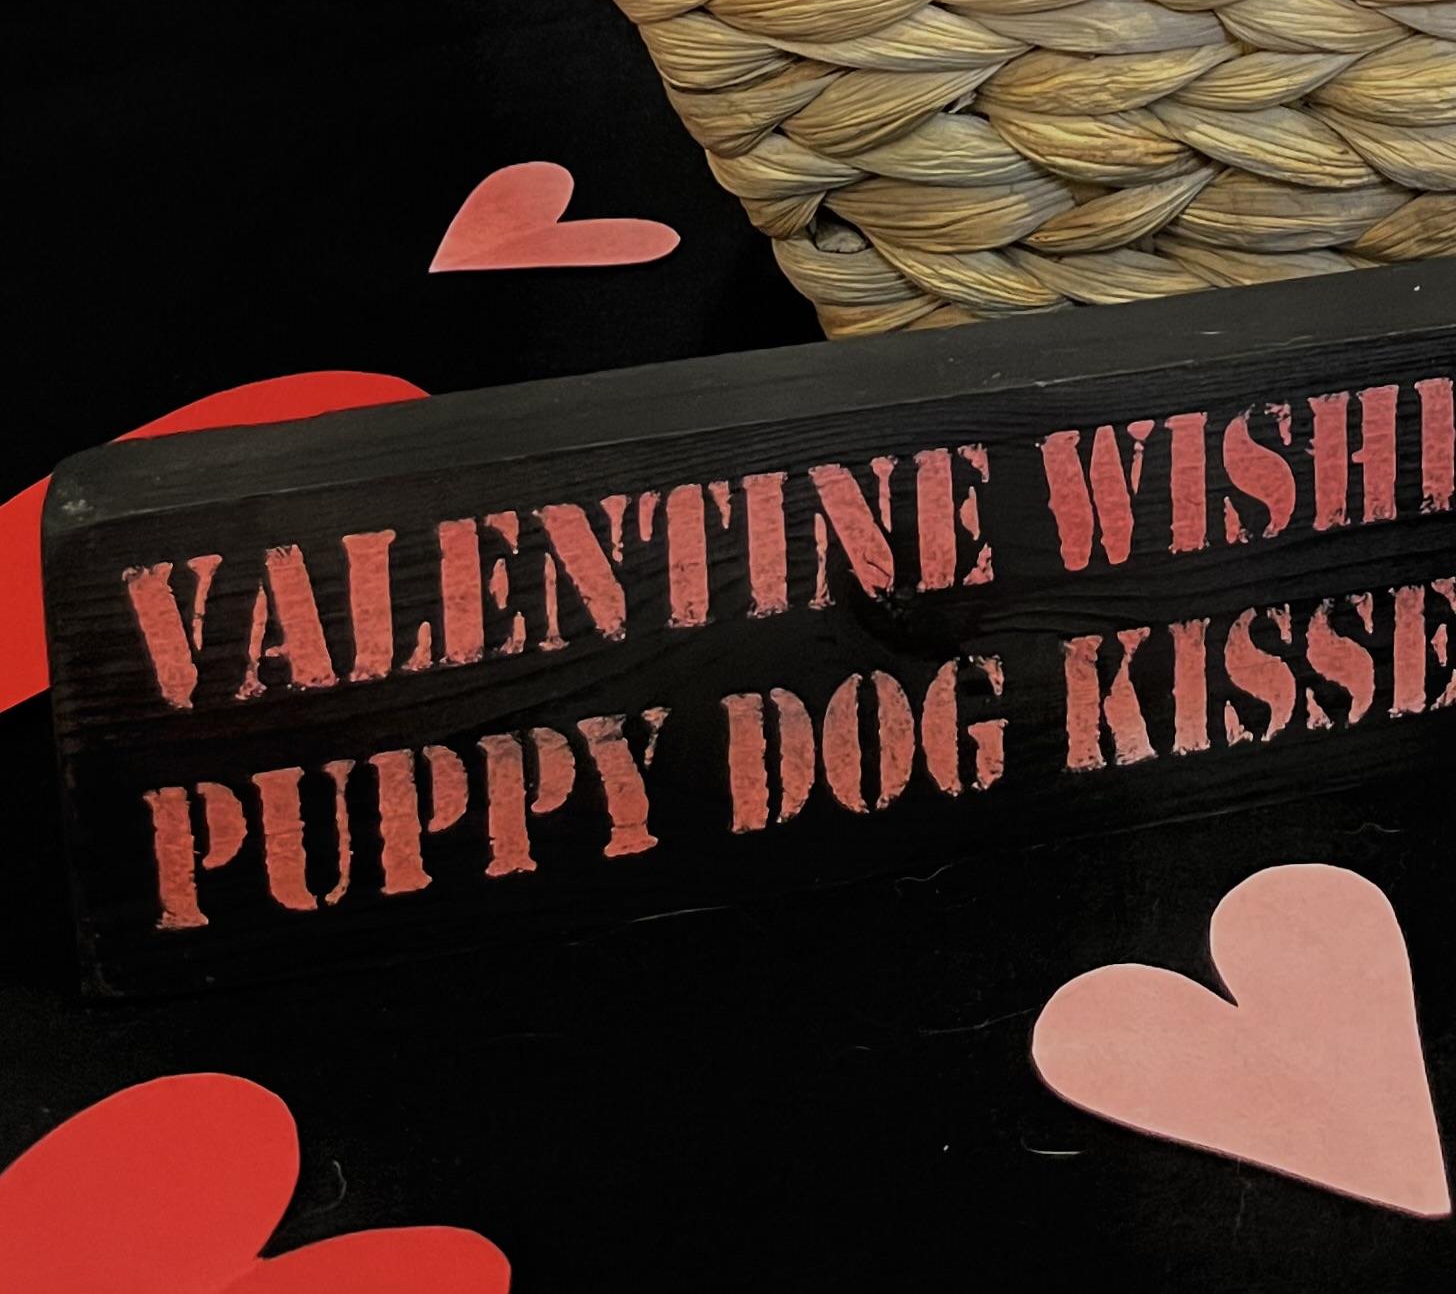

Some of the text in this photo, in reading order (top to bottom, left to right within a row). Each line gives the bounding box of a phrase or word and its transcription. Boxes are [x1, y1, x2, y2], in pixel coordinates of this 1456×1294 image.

[122, 446, 995, 710] VALENTINE
[143, 706, 669, 930] PUPPY
[722, 655, 1006, 833] DOG
